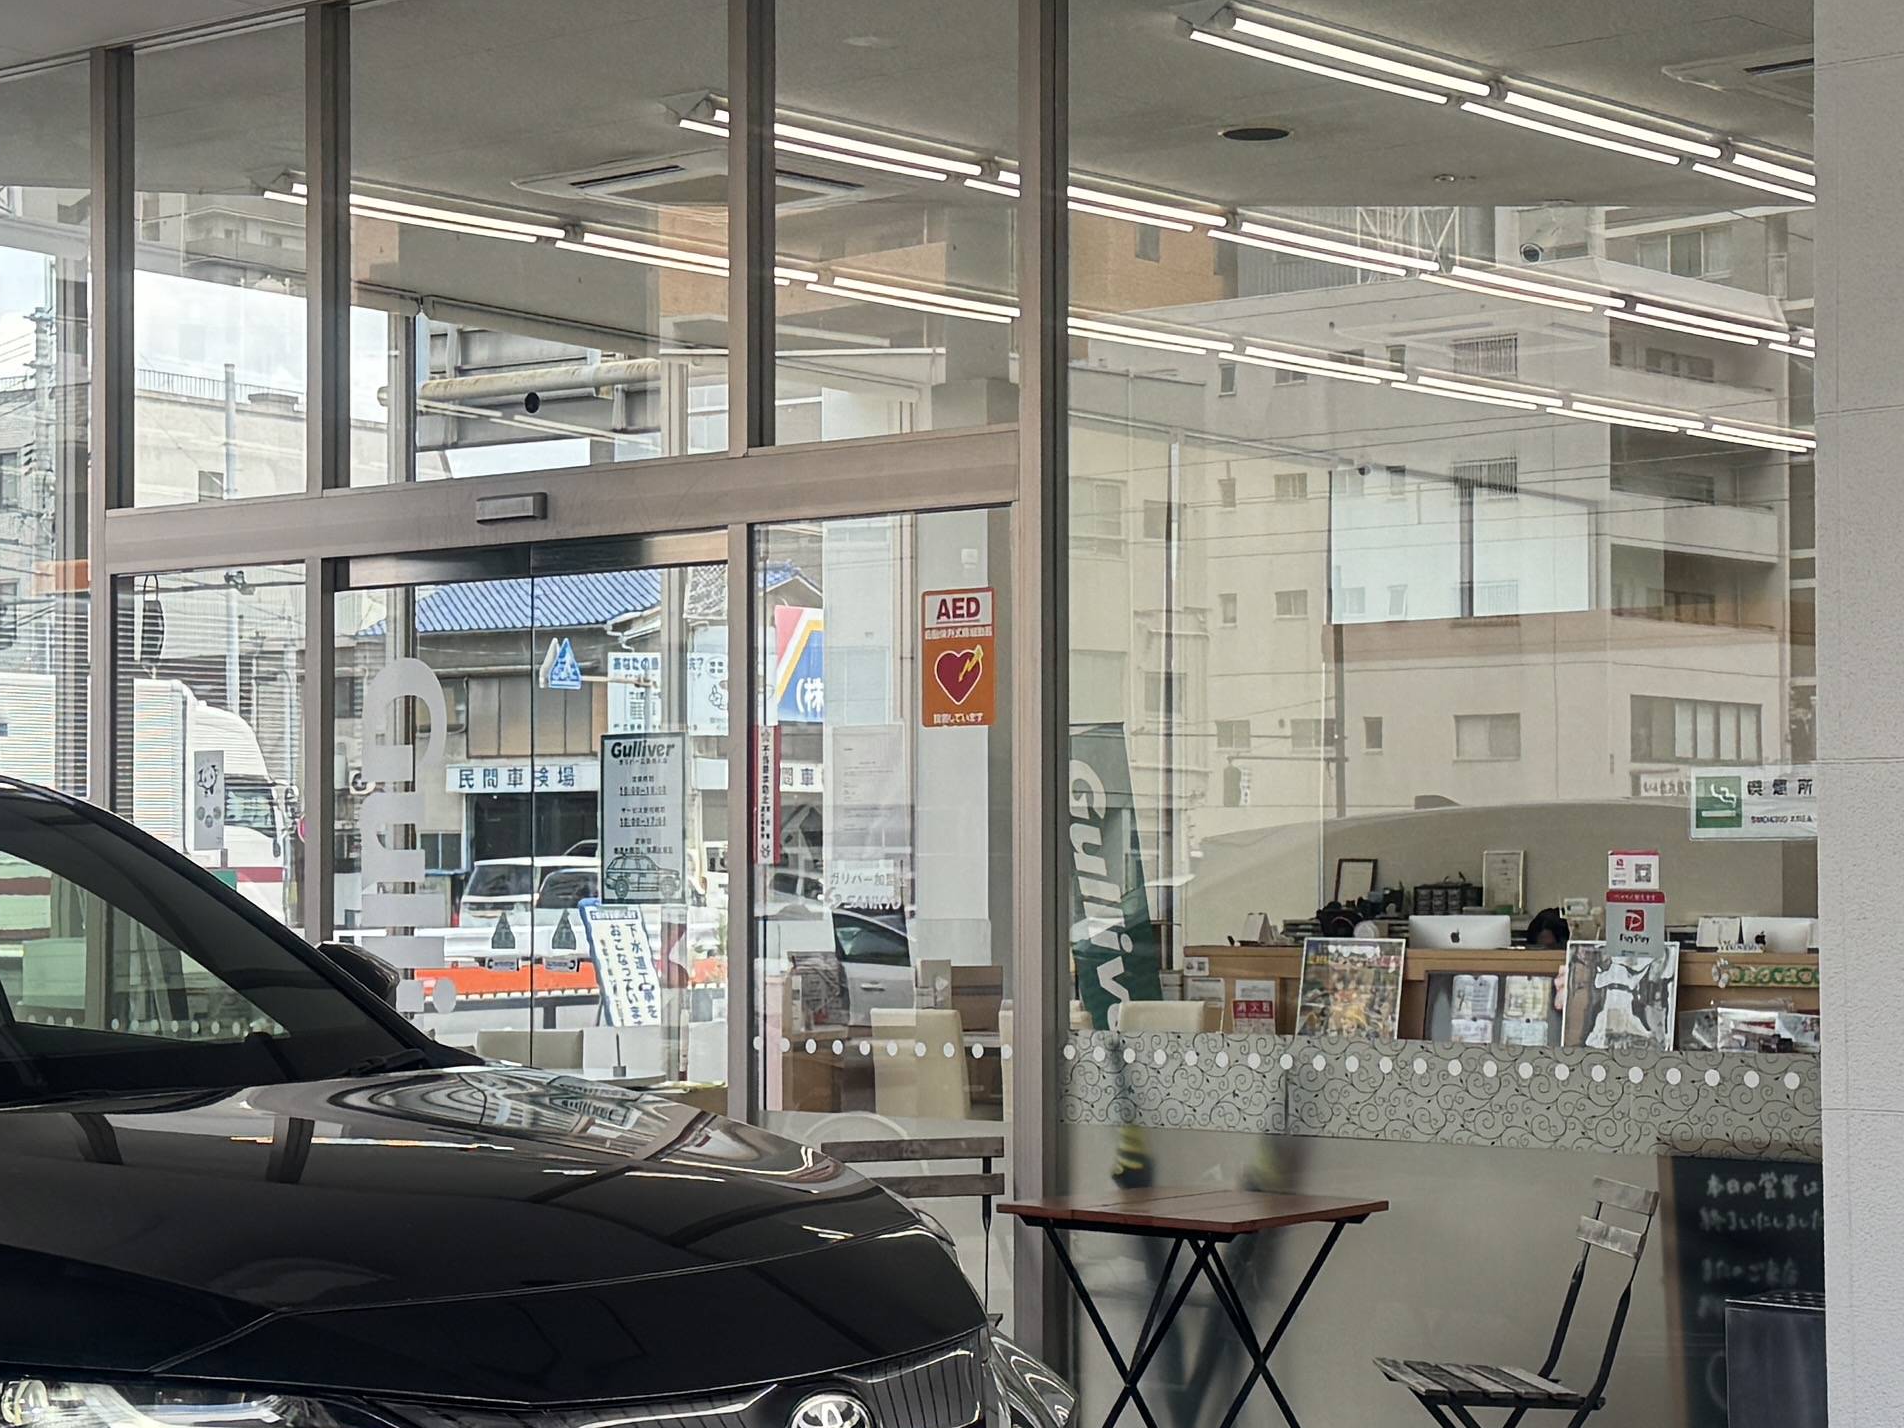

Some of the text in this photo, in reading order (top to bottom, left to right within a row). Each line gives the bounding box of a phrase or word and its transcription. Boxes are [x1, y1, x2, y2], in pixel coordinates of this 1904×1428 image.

[936, 596, 981, 621] AED
[611, 740, 676, 758] Gulliver
[458, 766, 576, 789] 民間車検場
[1746, 778, 1814, 796] 喫煙所
[1619, 933, 1650, 944] PayPay
